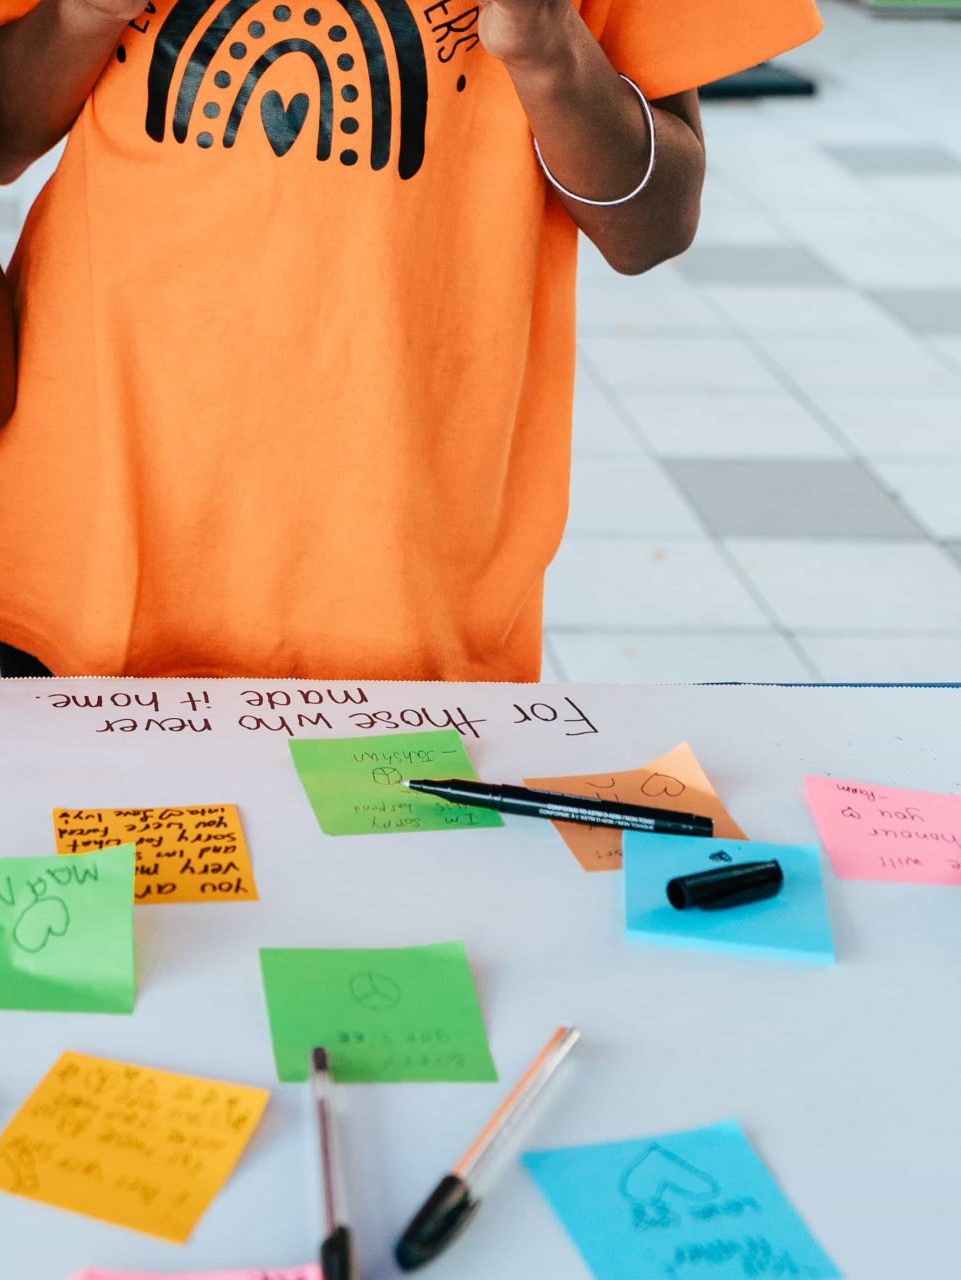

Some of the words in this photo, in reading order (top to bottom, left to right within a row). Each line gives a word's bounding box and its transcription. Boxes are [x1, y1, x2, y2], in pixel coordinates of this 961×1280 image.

[35, 690, 160, 712] home.
[179, 690, 213, 712] it
[239, 687, 369, 710] made
[94, 716, 213, 733] never
[237, 711, 333, 737] who
[348, 706, 488, 739] those
[512, 696, 599, 736] For
[194, 816, 228, 830] you
[878, 807, 925, 823] you
[124, 821, 184, 834] were
[135, 836, 164, 848] for
[198, 845, 237, 859] and
[179, 859, 241, 876] very
